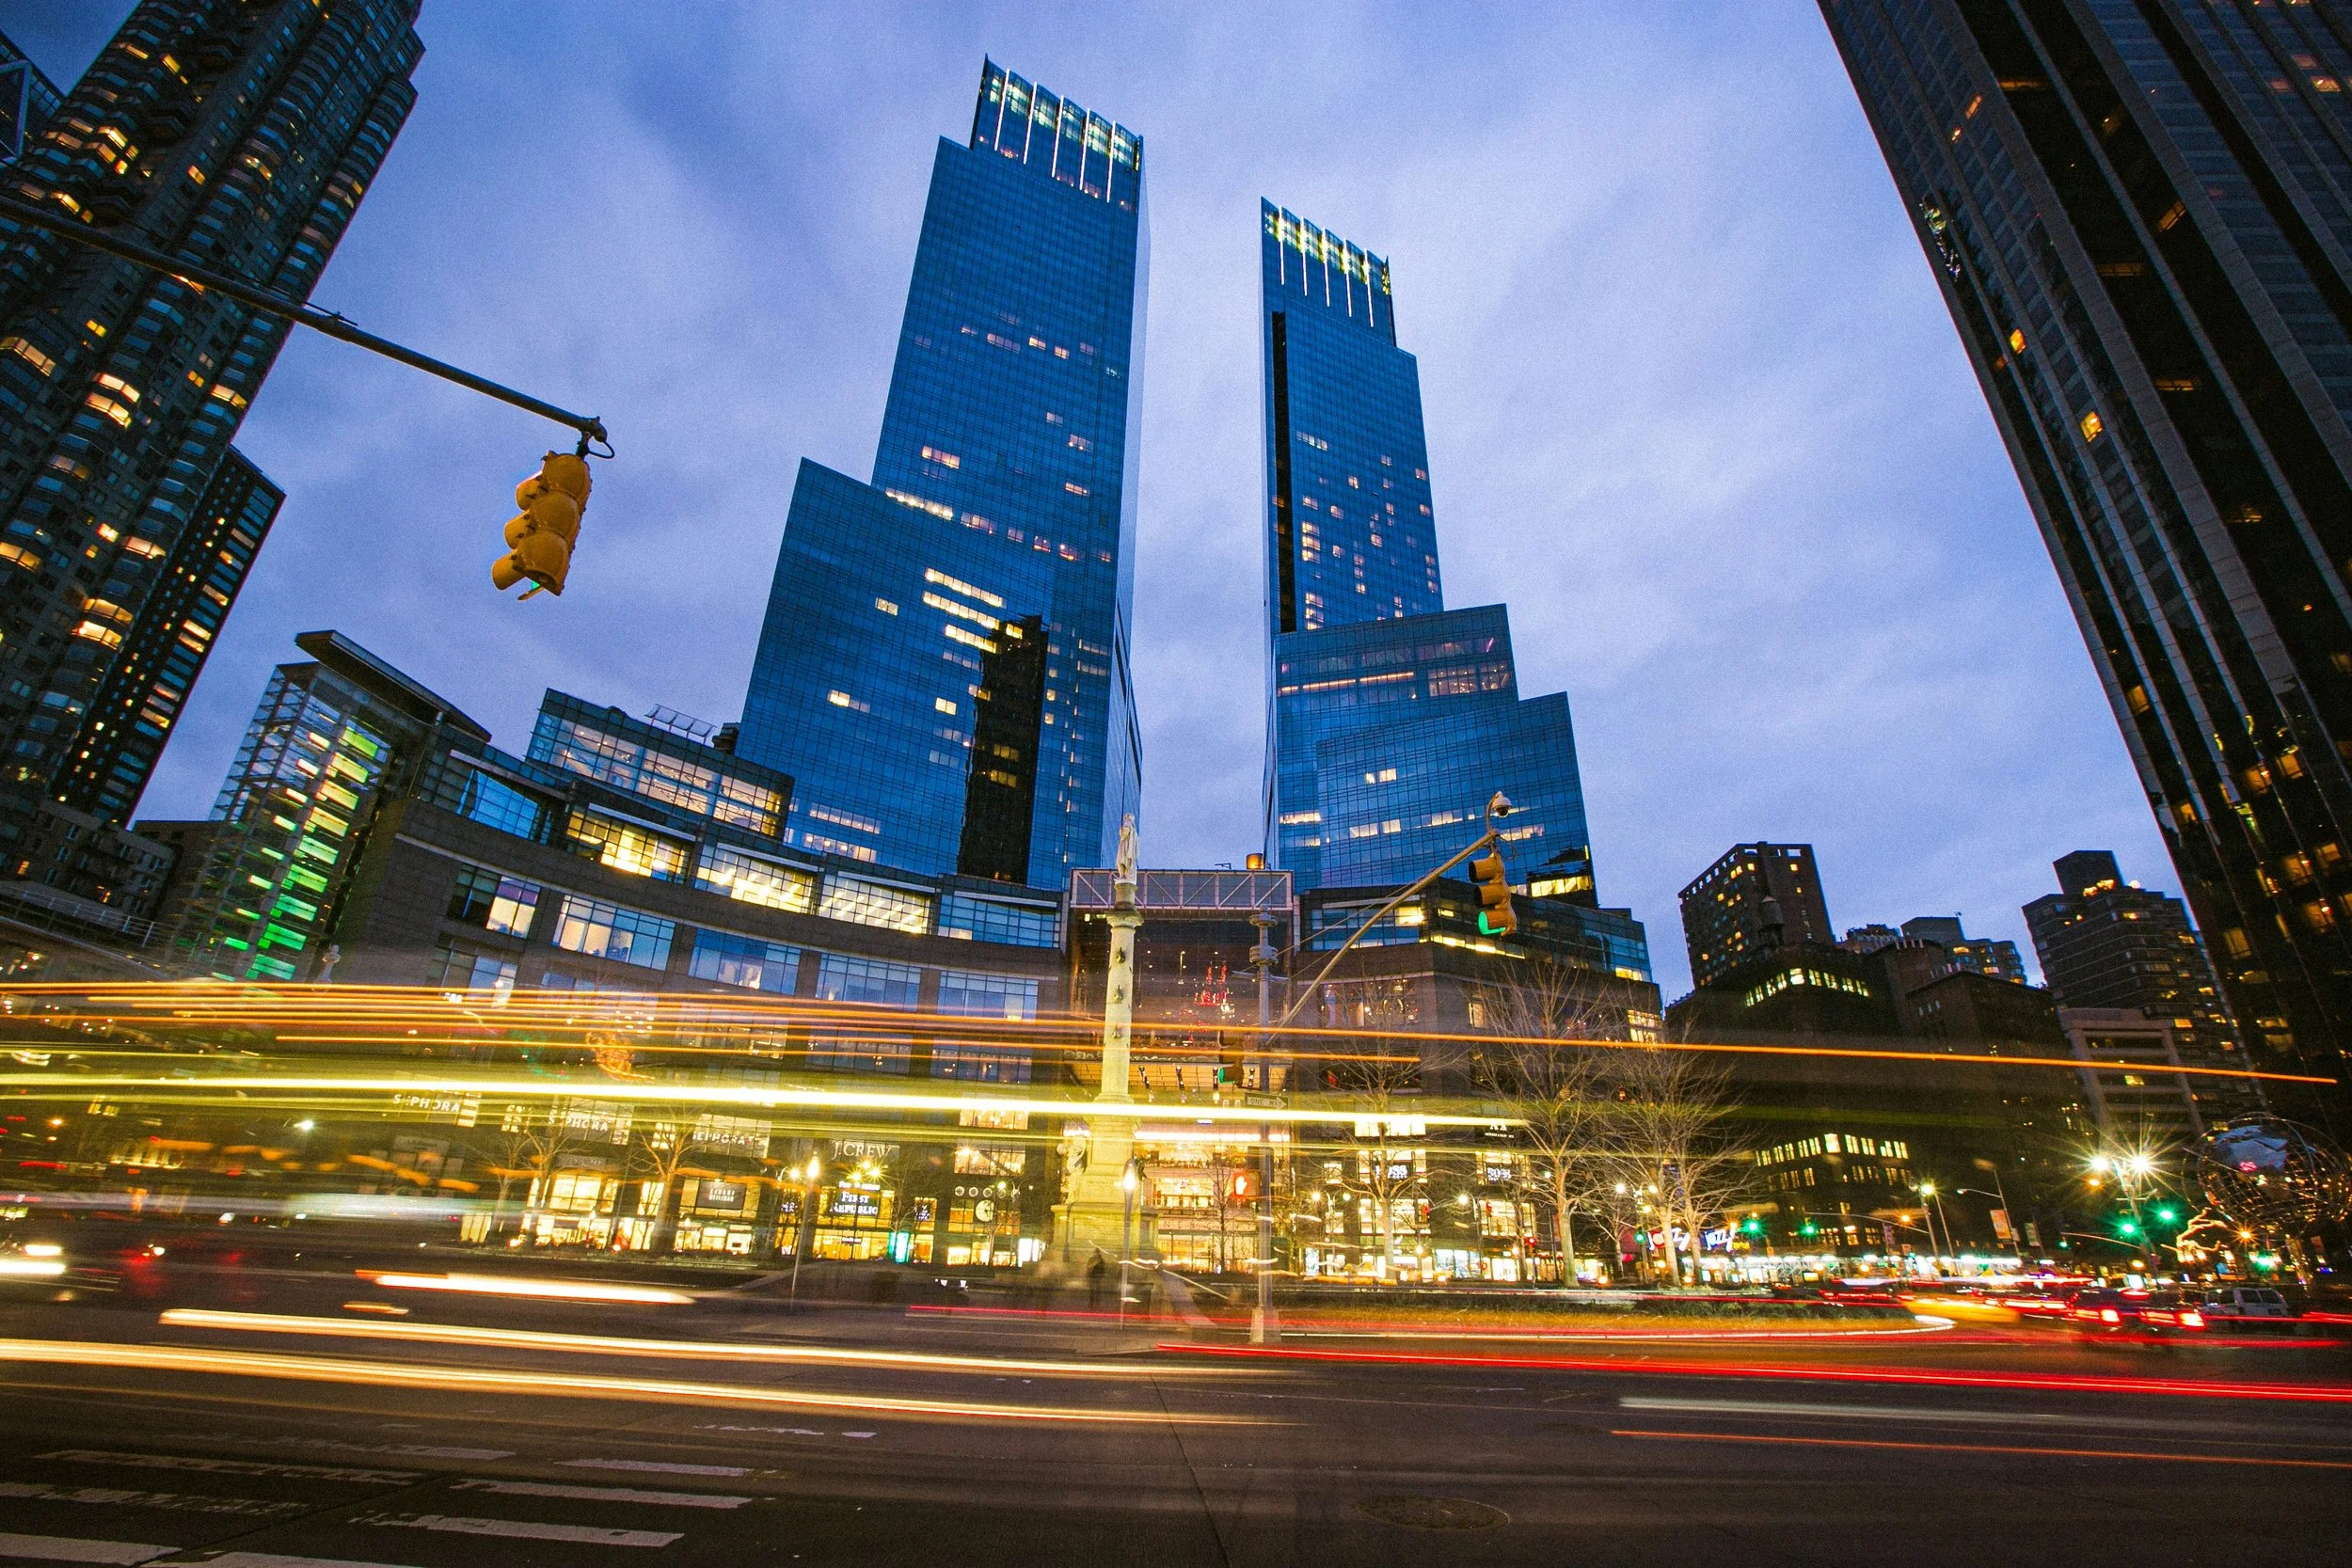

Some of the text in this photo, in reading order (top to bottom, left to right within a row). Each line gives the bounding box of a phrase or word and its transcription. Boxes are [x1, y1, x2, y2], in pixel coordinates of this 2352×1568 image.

[1250, 1097, 1282, 1108] ONE WAY
[548, 1110, 609, 1132] SPHORA
[832, 1141, 892, 1160] J.CREW
[841, 1191, 870, 1203] FIRST
